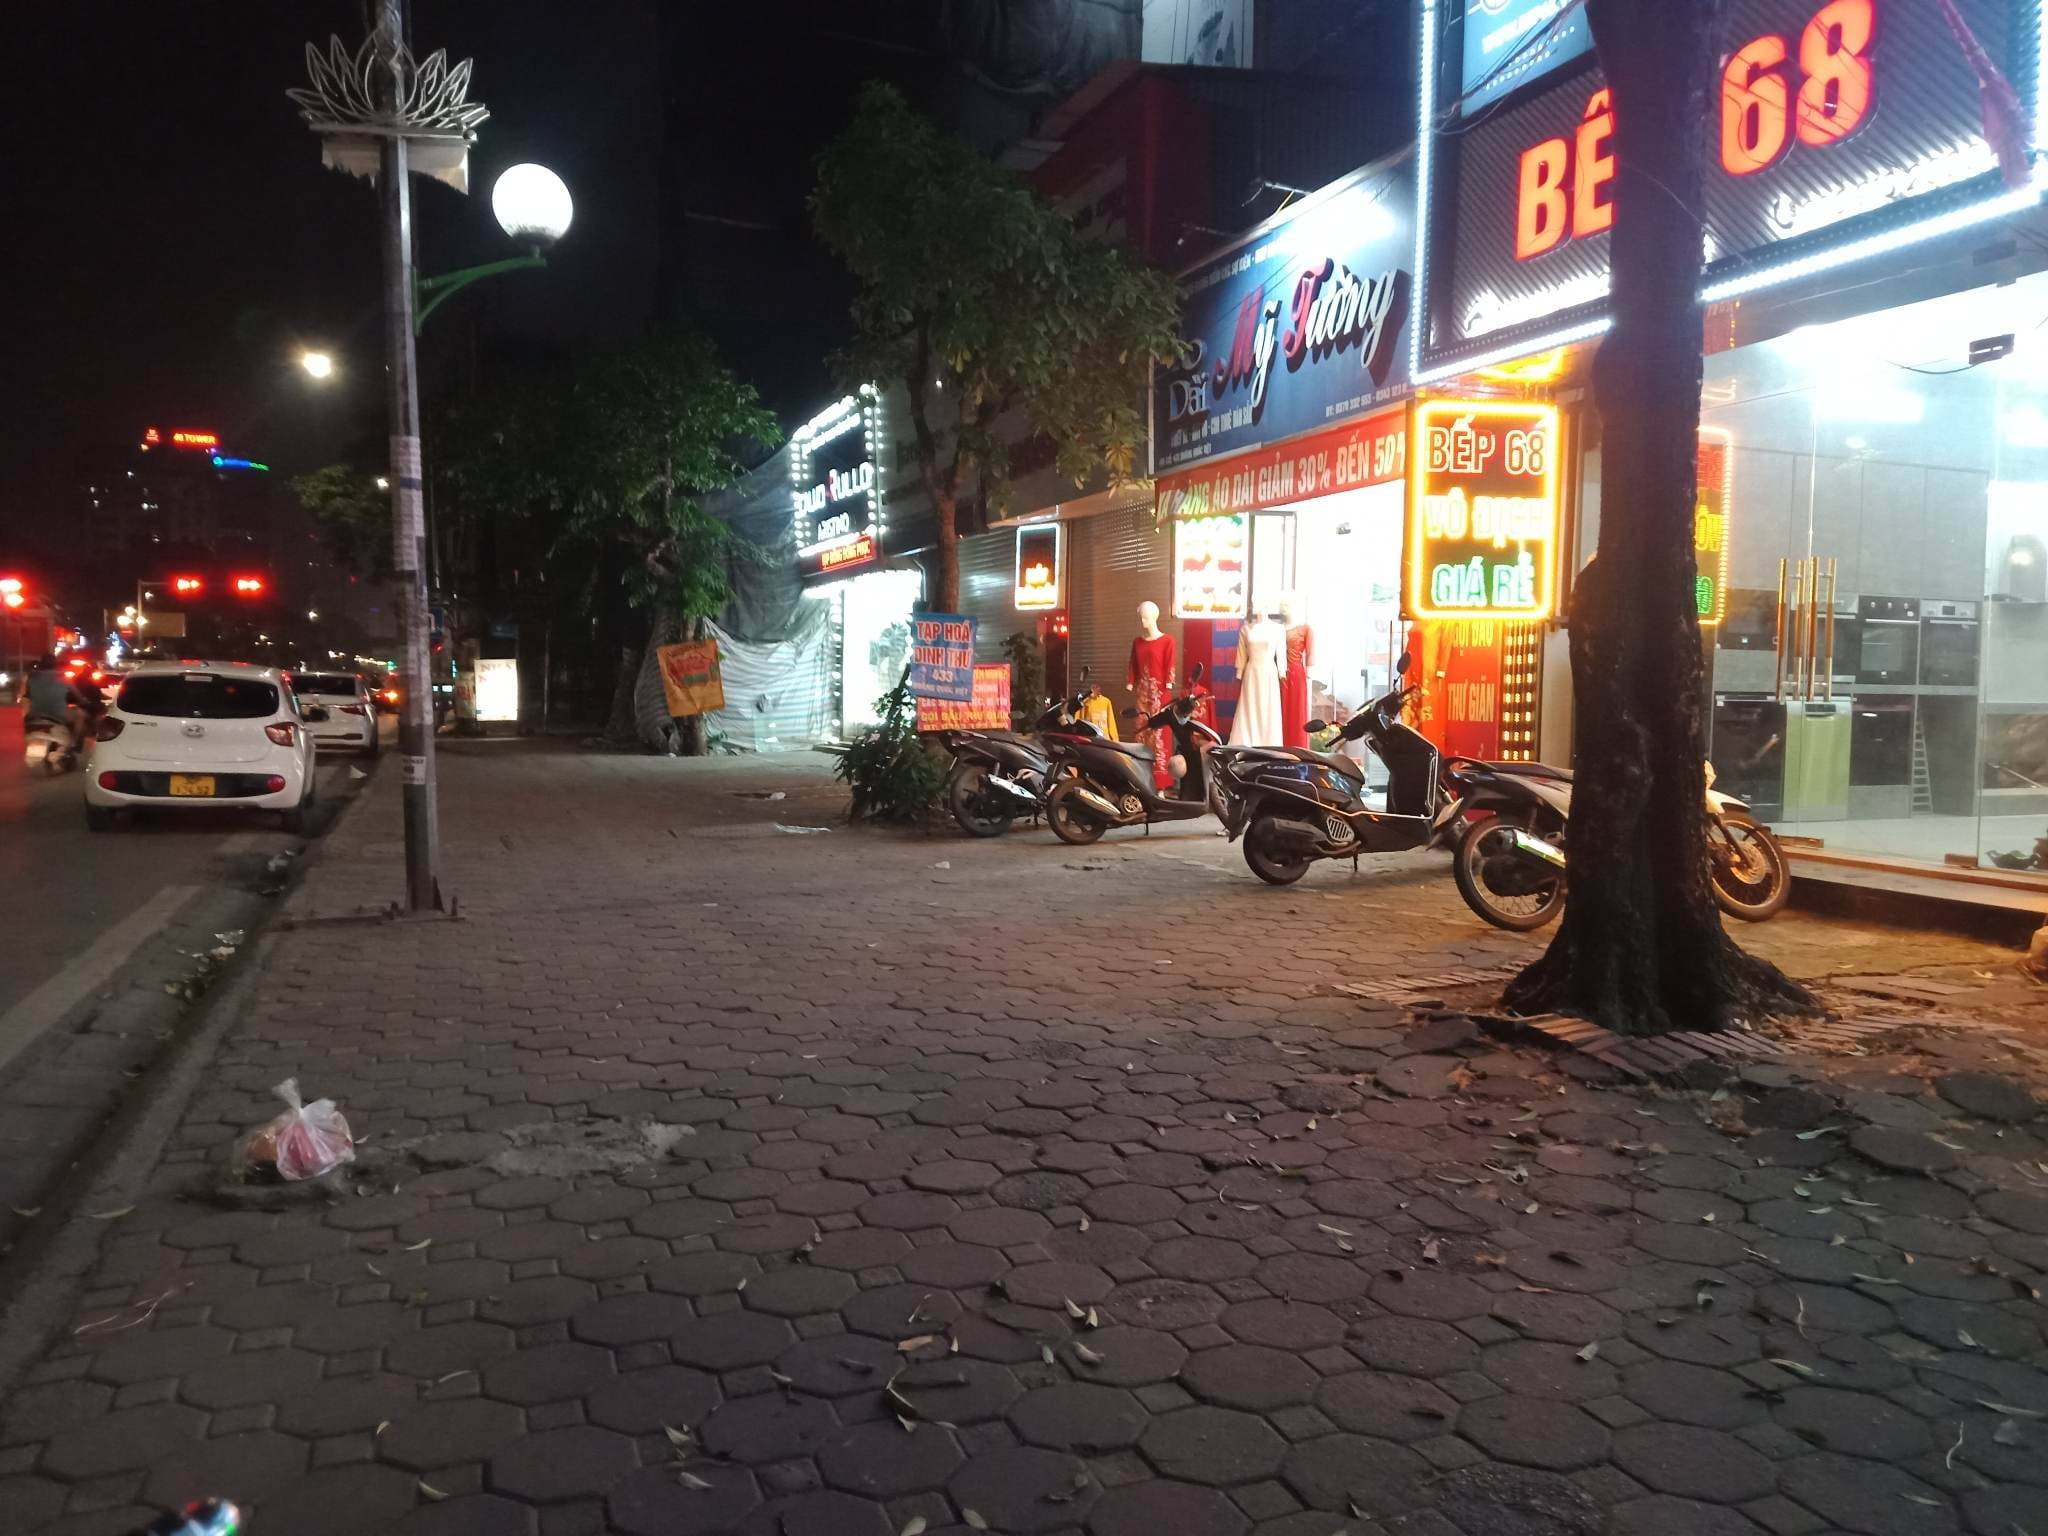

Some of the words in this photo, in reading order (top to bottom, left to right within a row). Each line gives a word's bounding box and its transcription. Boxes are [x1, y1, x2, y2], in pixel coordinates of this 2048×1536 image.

[1719, 0, 1876, 177] 68
[1212, 472, 1230, 512] ÁO
[1232, 465, 1256, 508] DÀI
[1258, 452, 1295, 503] GIẢM
[1297, 450, 1331, 495] 30%
[1336, 429, 1370, 486] ĐẾN
[1424, 413, 1497, 475] BẾP
[1504, 428, 1549, 476] 68
[1431, 556, 1487, 608] GIÁ
[1492, 550, 1536, 608] RẺ
[917, 621, 942, 644] TẠP
